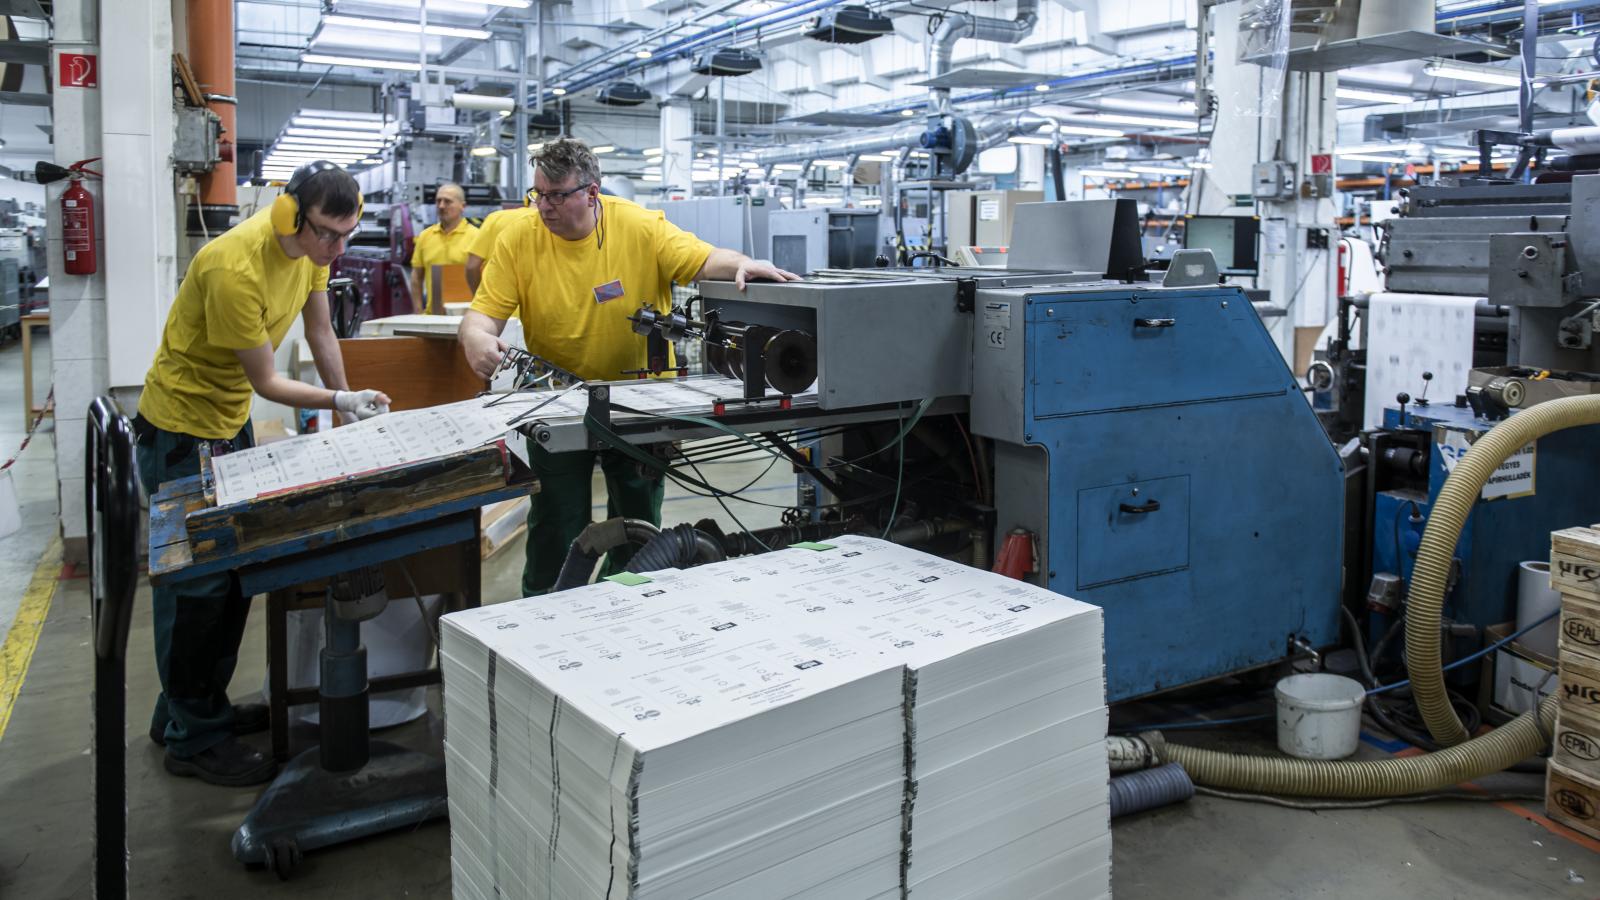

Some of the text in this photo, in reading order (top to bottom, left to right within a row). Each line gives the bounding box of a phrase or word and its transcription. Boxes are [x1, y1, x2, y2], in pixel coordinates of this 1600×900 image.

[1487, 471, 1531, 484] APÍRHULLADÉK
[1568, 621, 1600, 643] EPAL
[1565, 736, 1595, 758] EPAL
